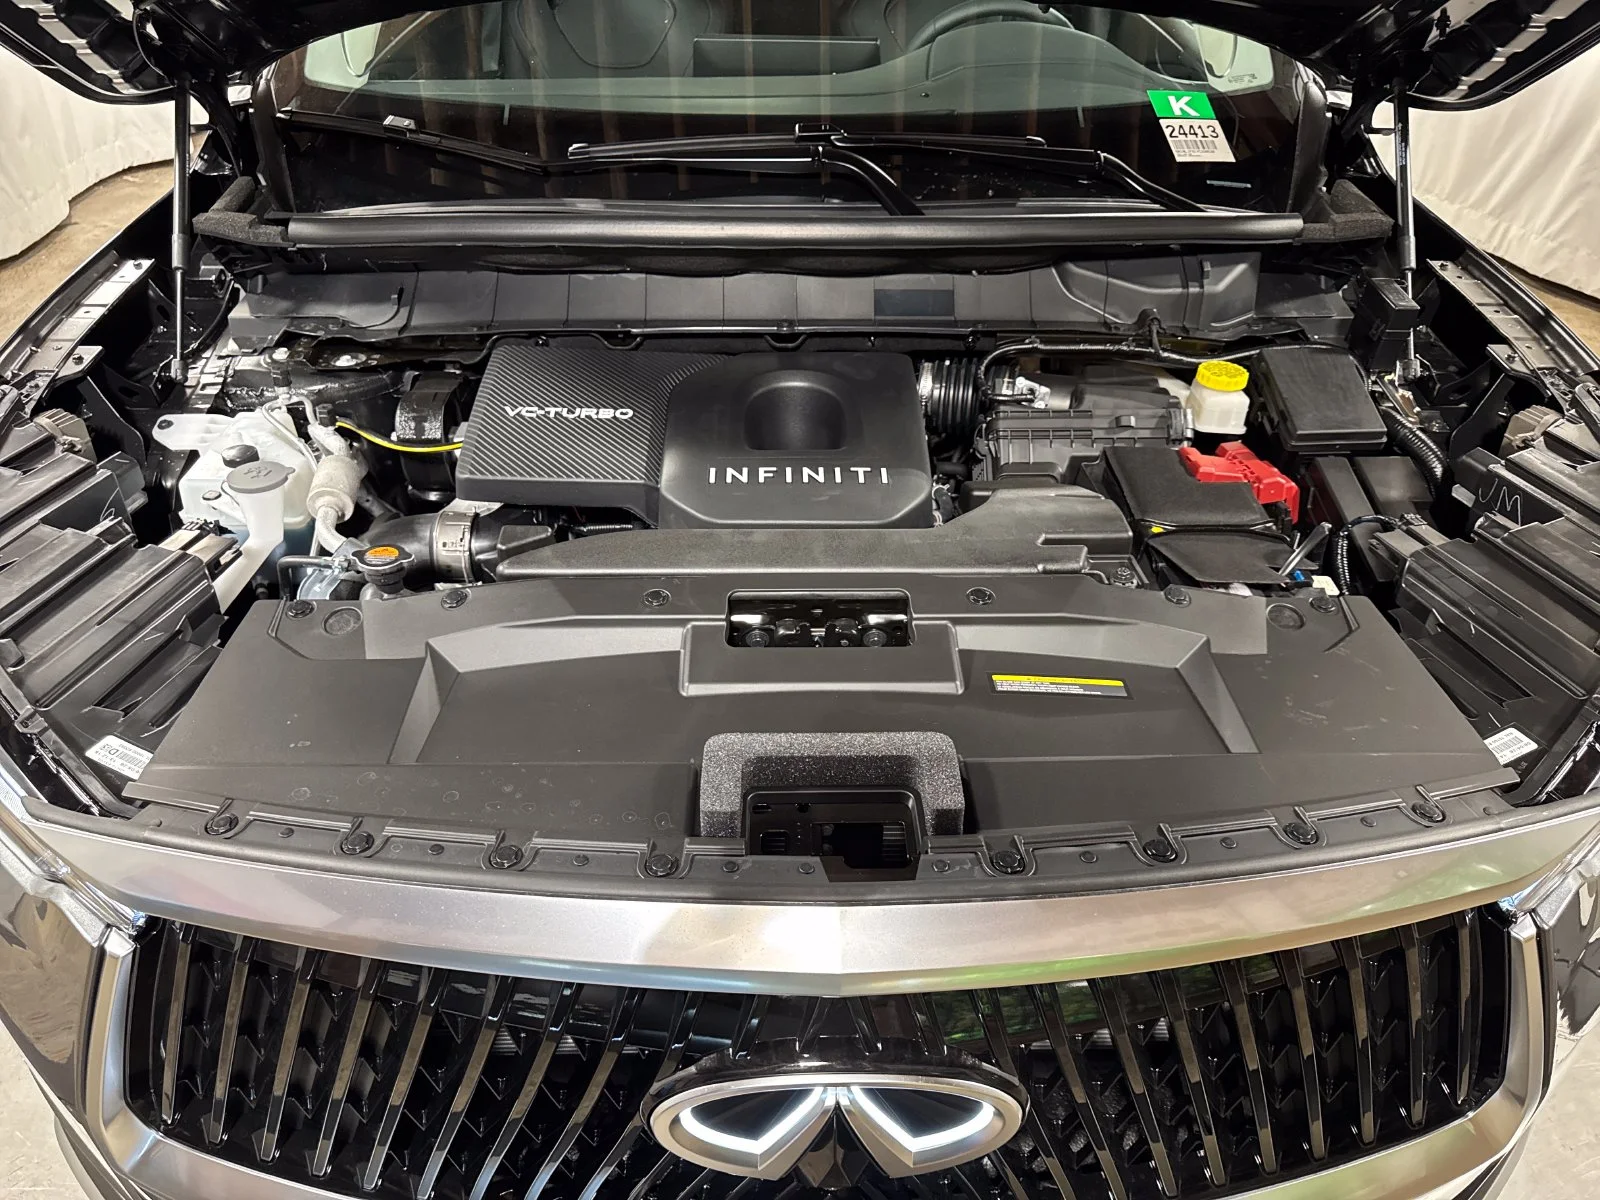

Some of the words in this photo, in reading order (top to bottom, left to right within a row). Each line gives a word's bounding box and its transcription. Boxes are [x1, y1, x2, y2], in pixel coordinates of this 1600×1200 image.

[1167, 95, 1201, 117] K
[1165, 124, 1219, 139] 24413
[504, 405, 634, 420] VC-TURBO
[708, 466, 890, 484] INFINITI
